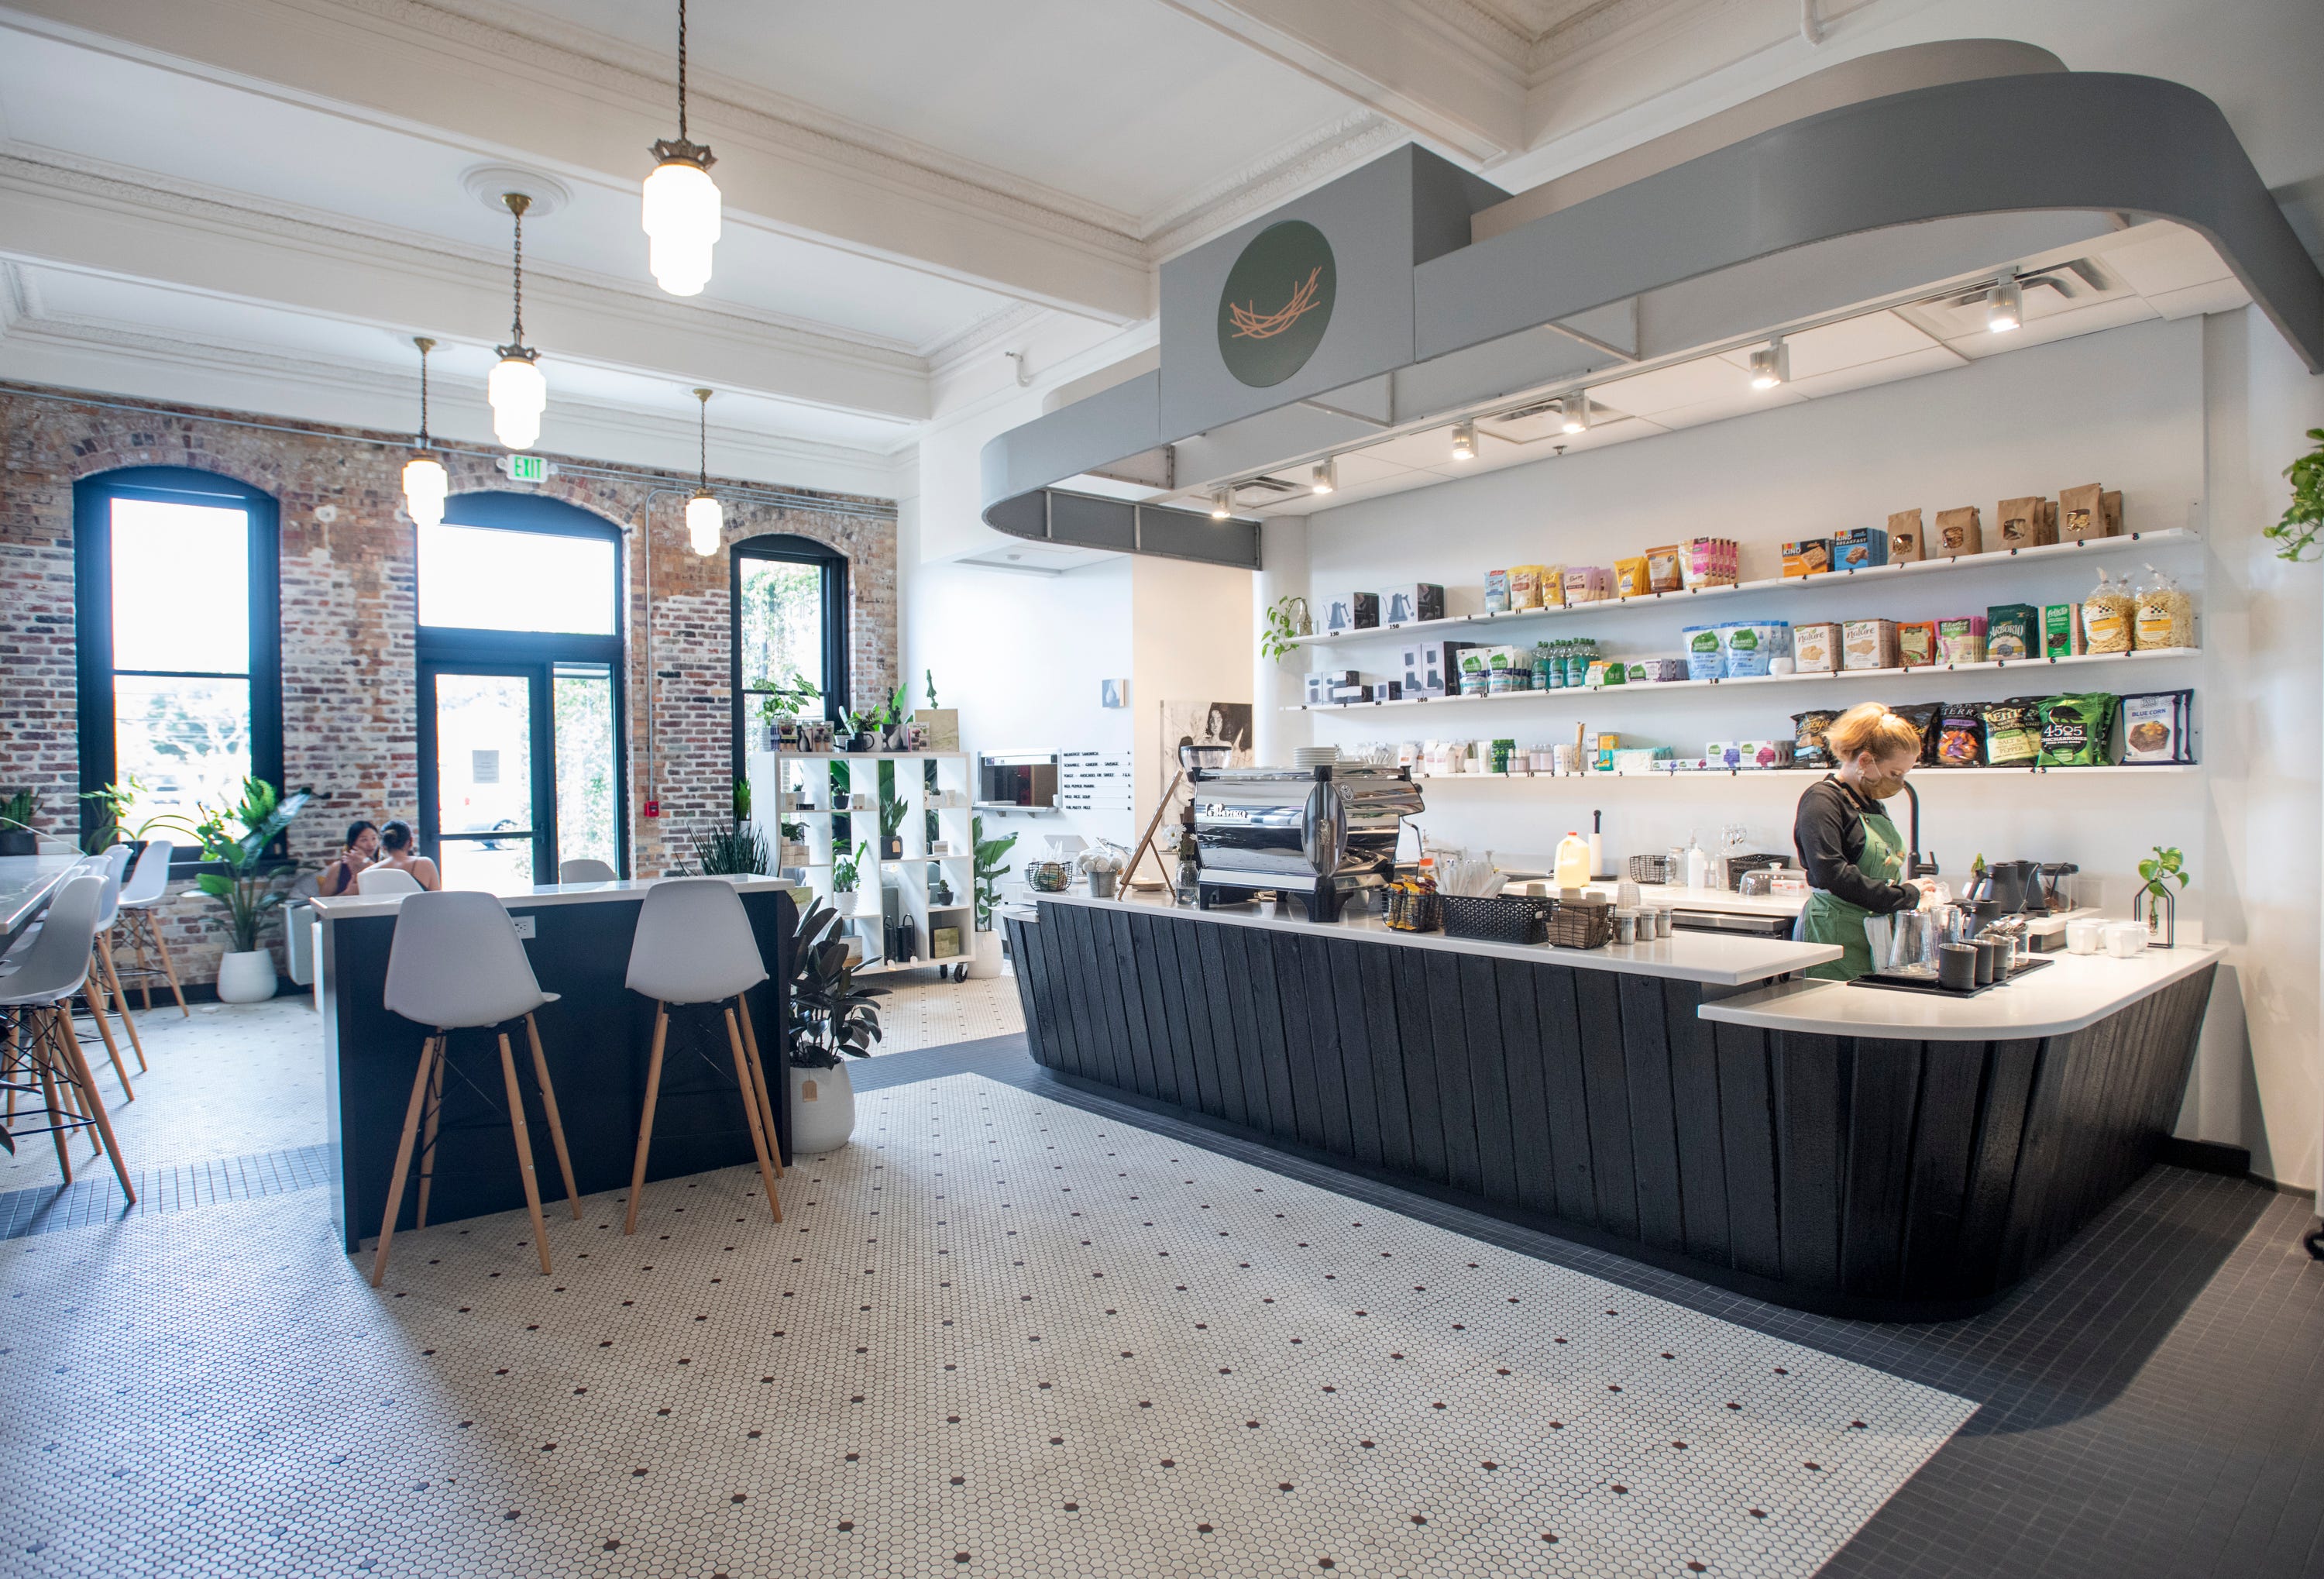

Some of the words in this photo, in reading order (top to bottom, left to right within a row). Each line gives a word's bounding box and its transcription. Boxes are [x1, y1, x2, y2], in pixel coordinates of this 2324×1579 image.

[514, 456, 542, 479] EXIT
[1783, 547, 1801, 556] KIND
[1798, 631, 1824, 643] nature
[1847, 627, 1875, 639] nature
[1989, 624, 2024, 639] ARBORIO
[1983, 708, 2025, 722] KETTL
[2044, 725, 2083, 737] 4505
